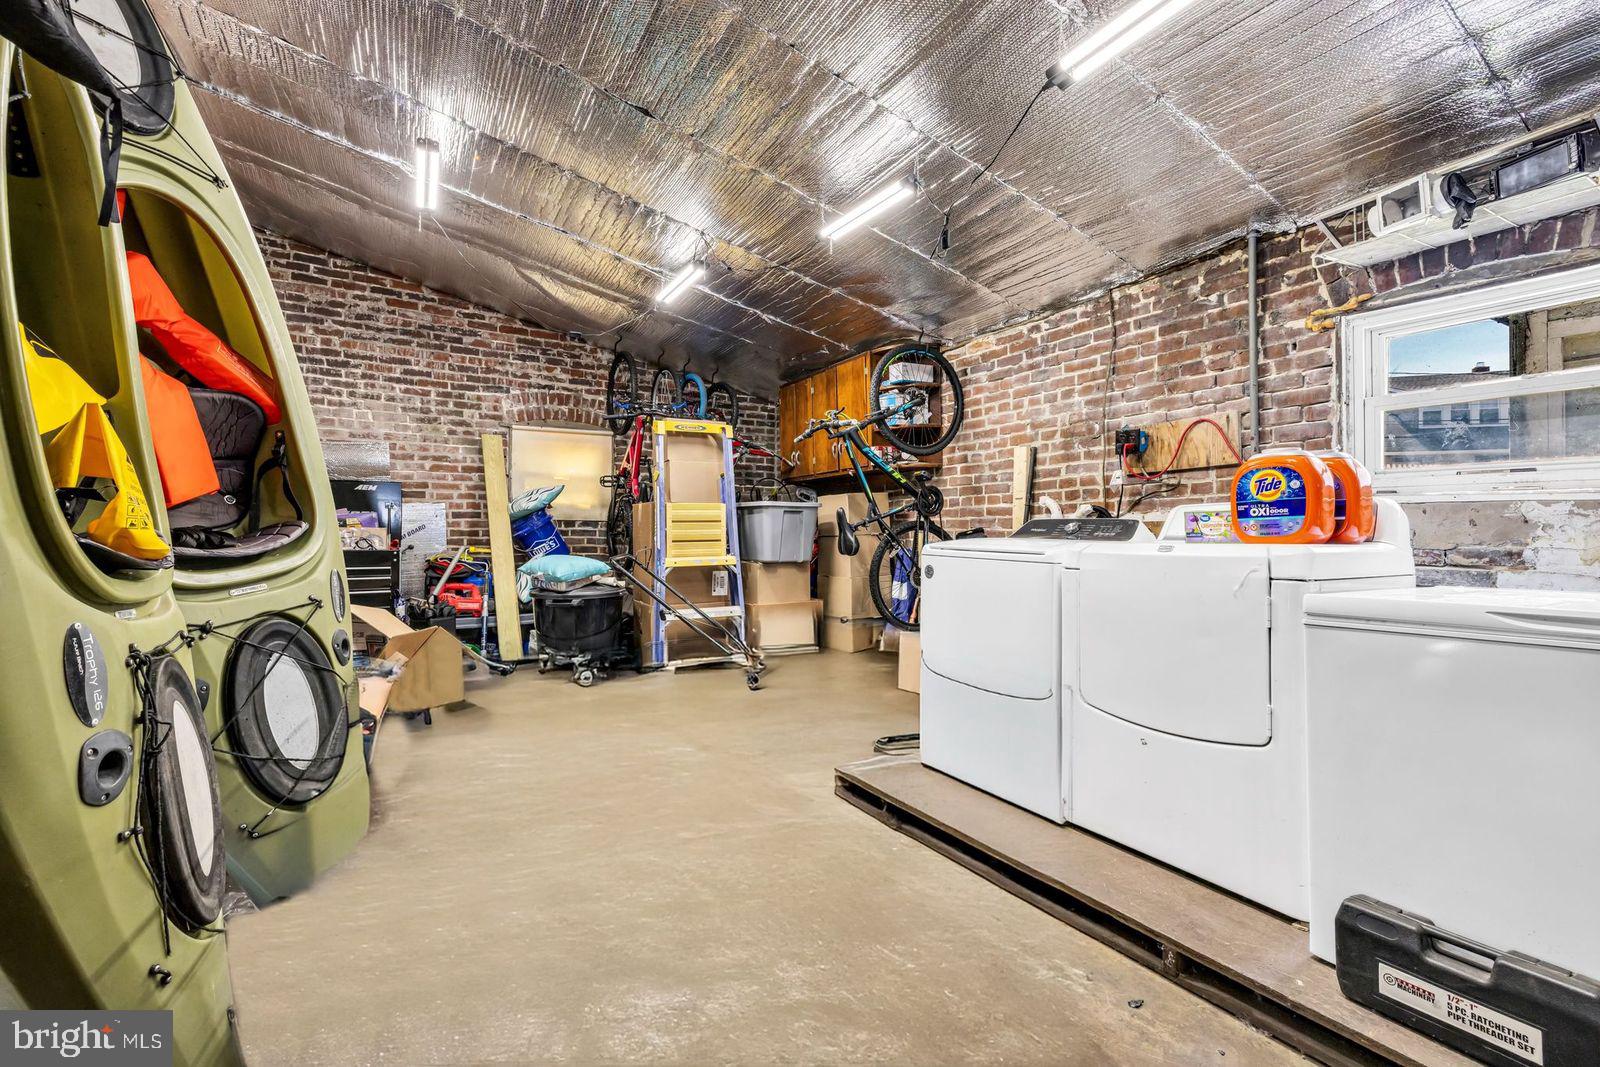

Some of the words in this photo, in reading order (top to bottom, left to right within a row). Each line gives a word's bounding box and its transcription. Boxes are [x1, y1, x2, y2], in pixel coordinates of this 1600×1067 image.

[1255, 477, 1282, 496] Tide
[1249, 508, 1270, 516] OXI
[407, 523, 427, 538] BOARD
[94, 689, 104, 711] 126
[1396, 982, 1435, 1004] MACHINERY
[1447, 1002, 1453, 1010] 5
[1455, 1005, 1469, 1018] PC.
[1470, 1012, 1529, 1044] RATCHETING
[1447, 1010, 1467, 1024] PIPE
[1468, 1019, 1516, 1047] THREADER
[1517, 1041, 1536, 1055] SET
